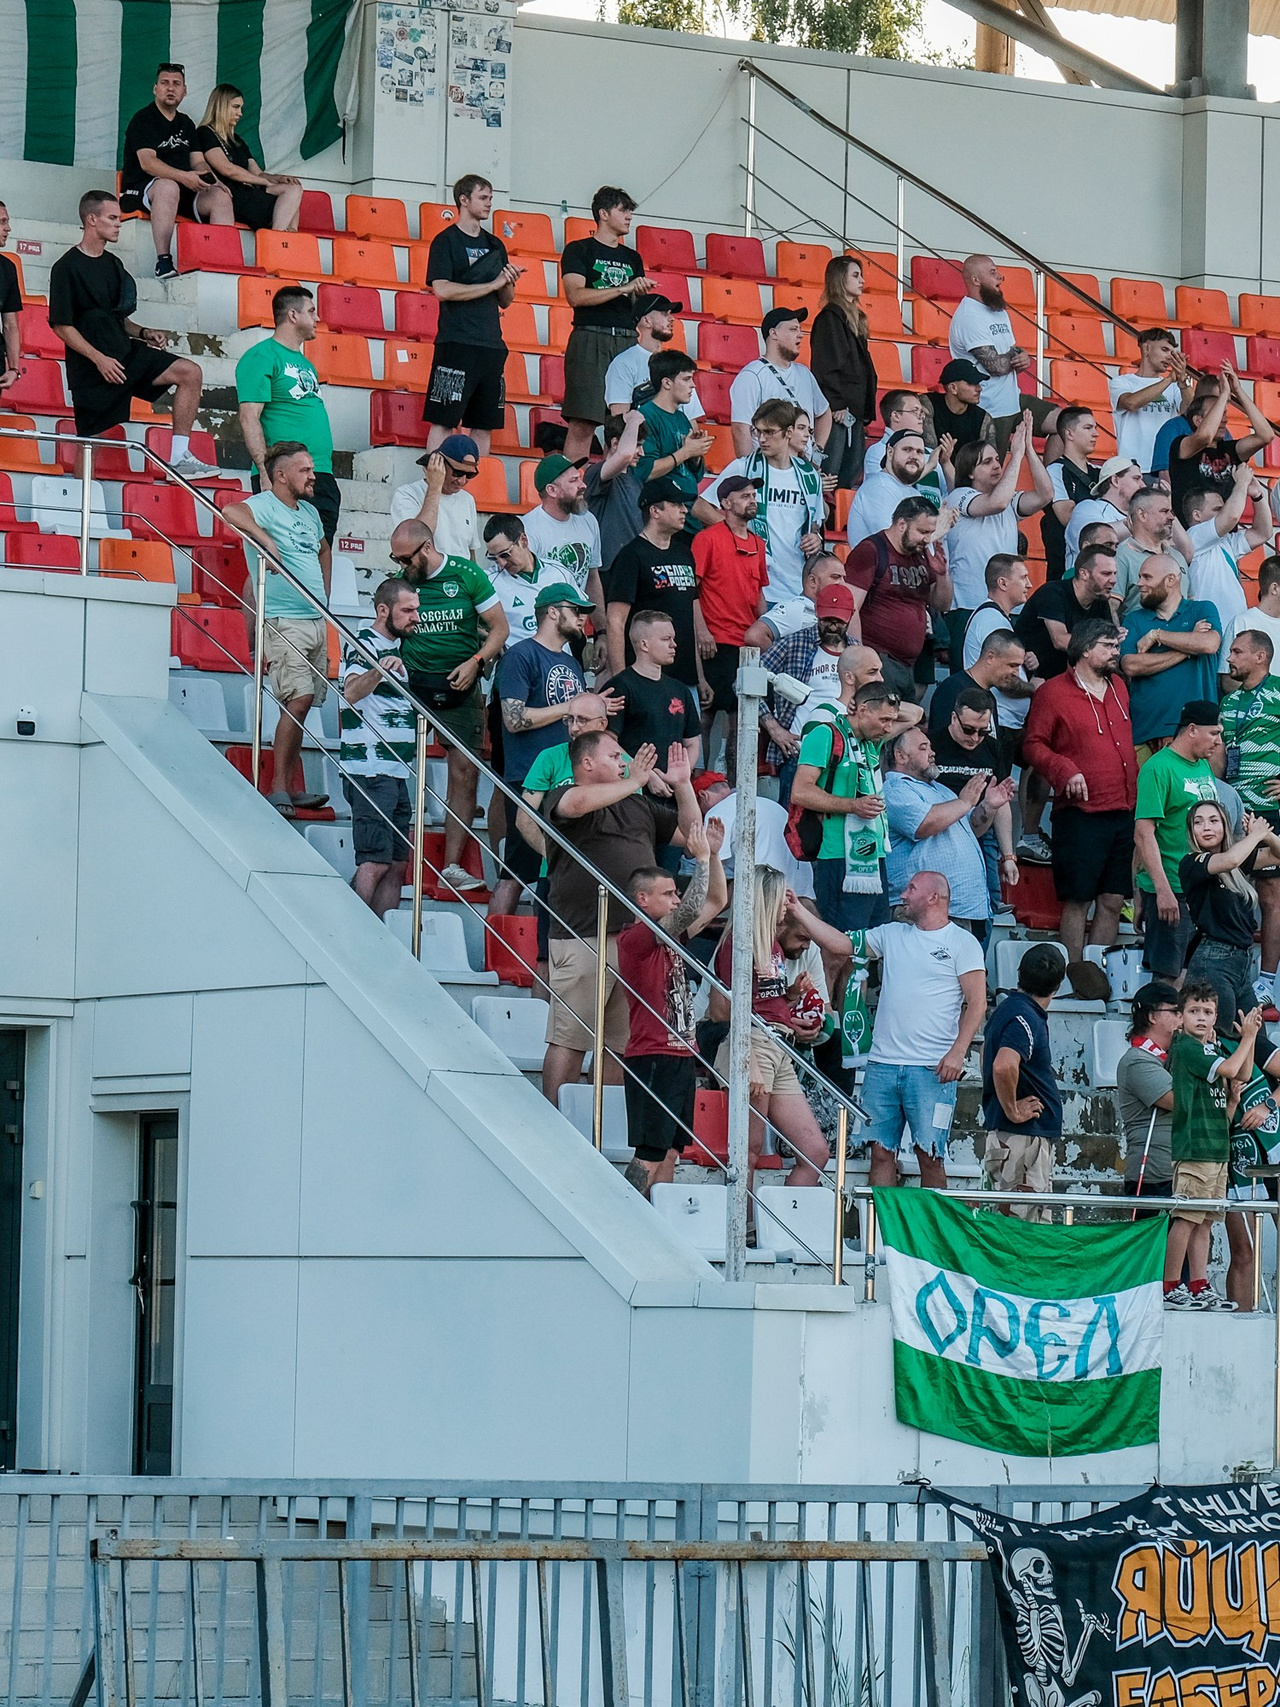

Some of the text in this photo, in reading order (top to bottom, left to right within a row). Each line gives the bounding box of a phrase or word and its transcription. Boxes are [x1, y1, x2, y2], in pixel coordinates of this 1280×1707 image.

[19, 243, 27, 251] 17
[340, 839, 344, 847] 1
[519, 928, 524, 936] 2
[507, 1011, 511, 1019] 1
[700, 1103, 705, 1111] 2
[793, 1200, 797, 1208] 2
[915, 1270, 1123, 1381] ОРЕЛ
